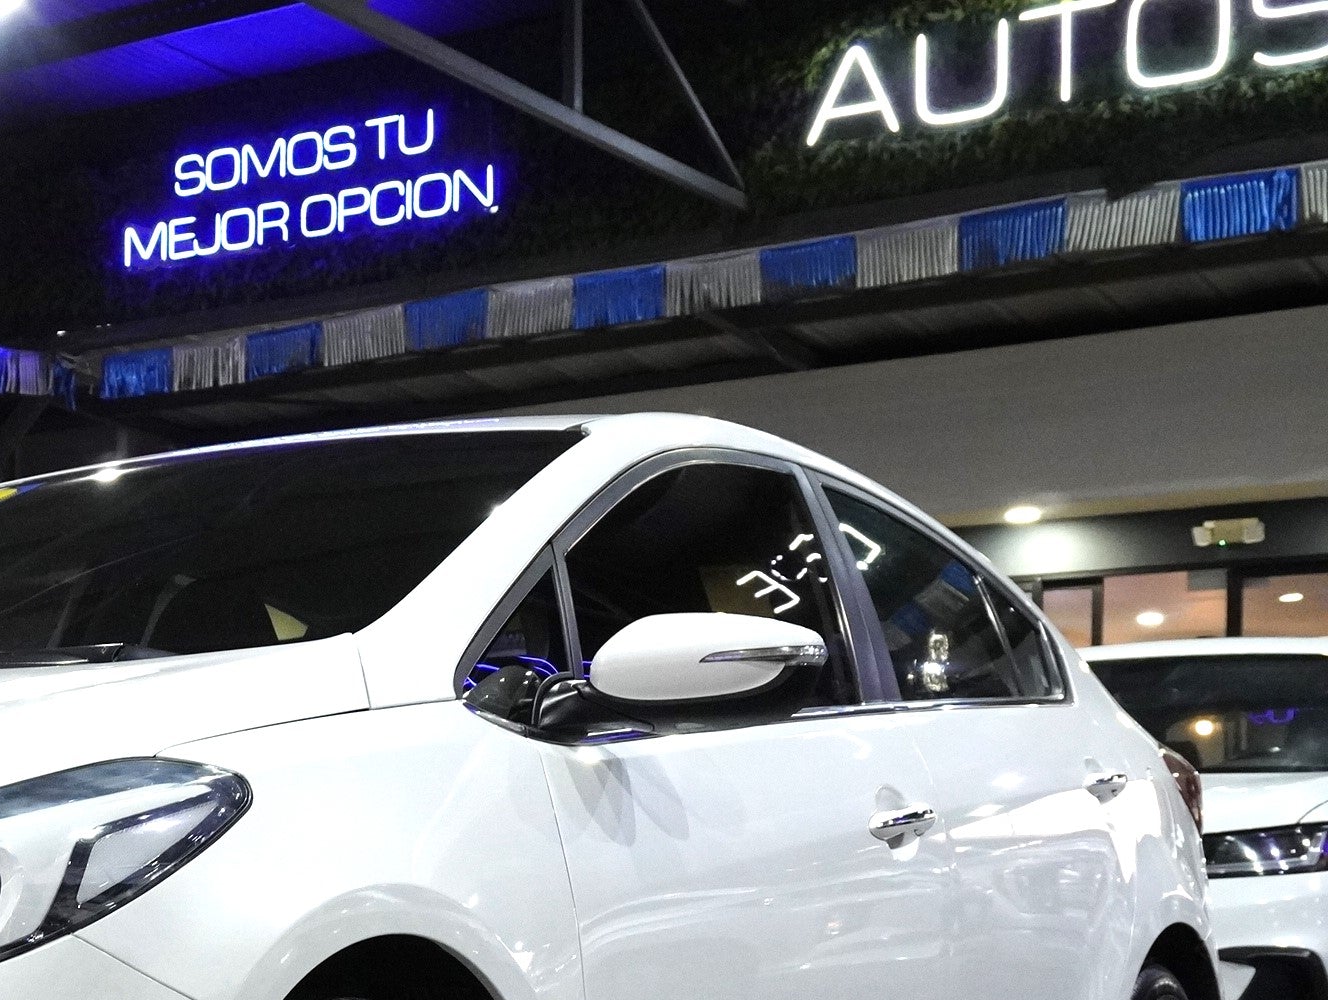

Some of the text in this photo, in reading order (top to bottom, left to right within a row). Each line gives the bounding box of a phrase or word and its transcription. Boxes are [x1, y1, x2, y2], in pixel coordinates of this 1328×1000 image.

[174, 108, 434, 198] SOMOS TU
[123, 201, 289, 267] MEJOR
